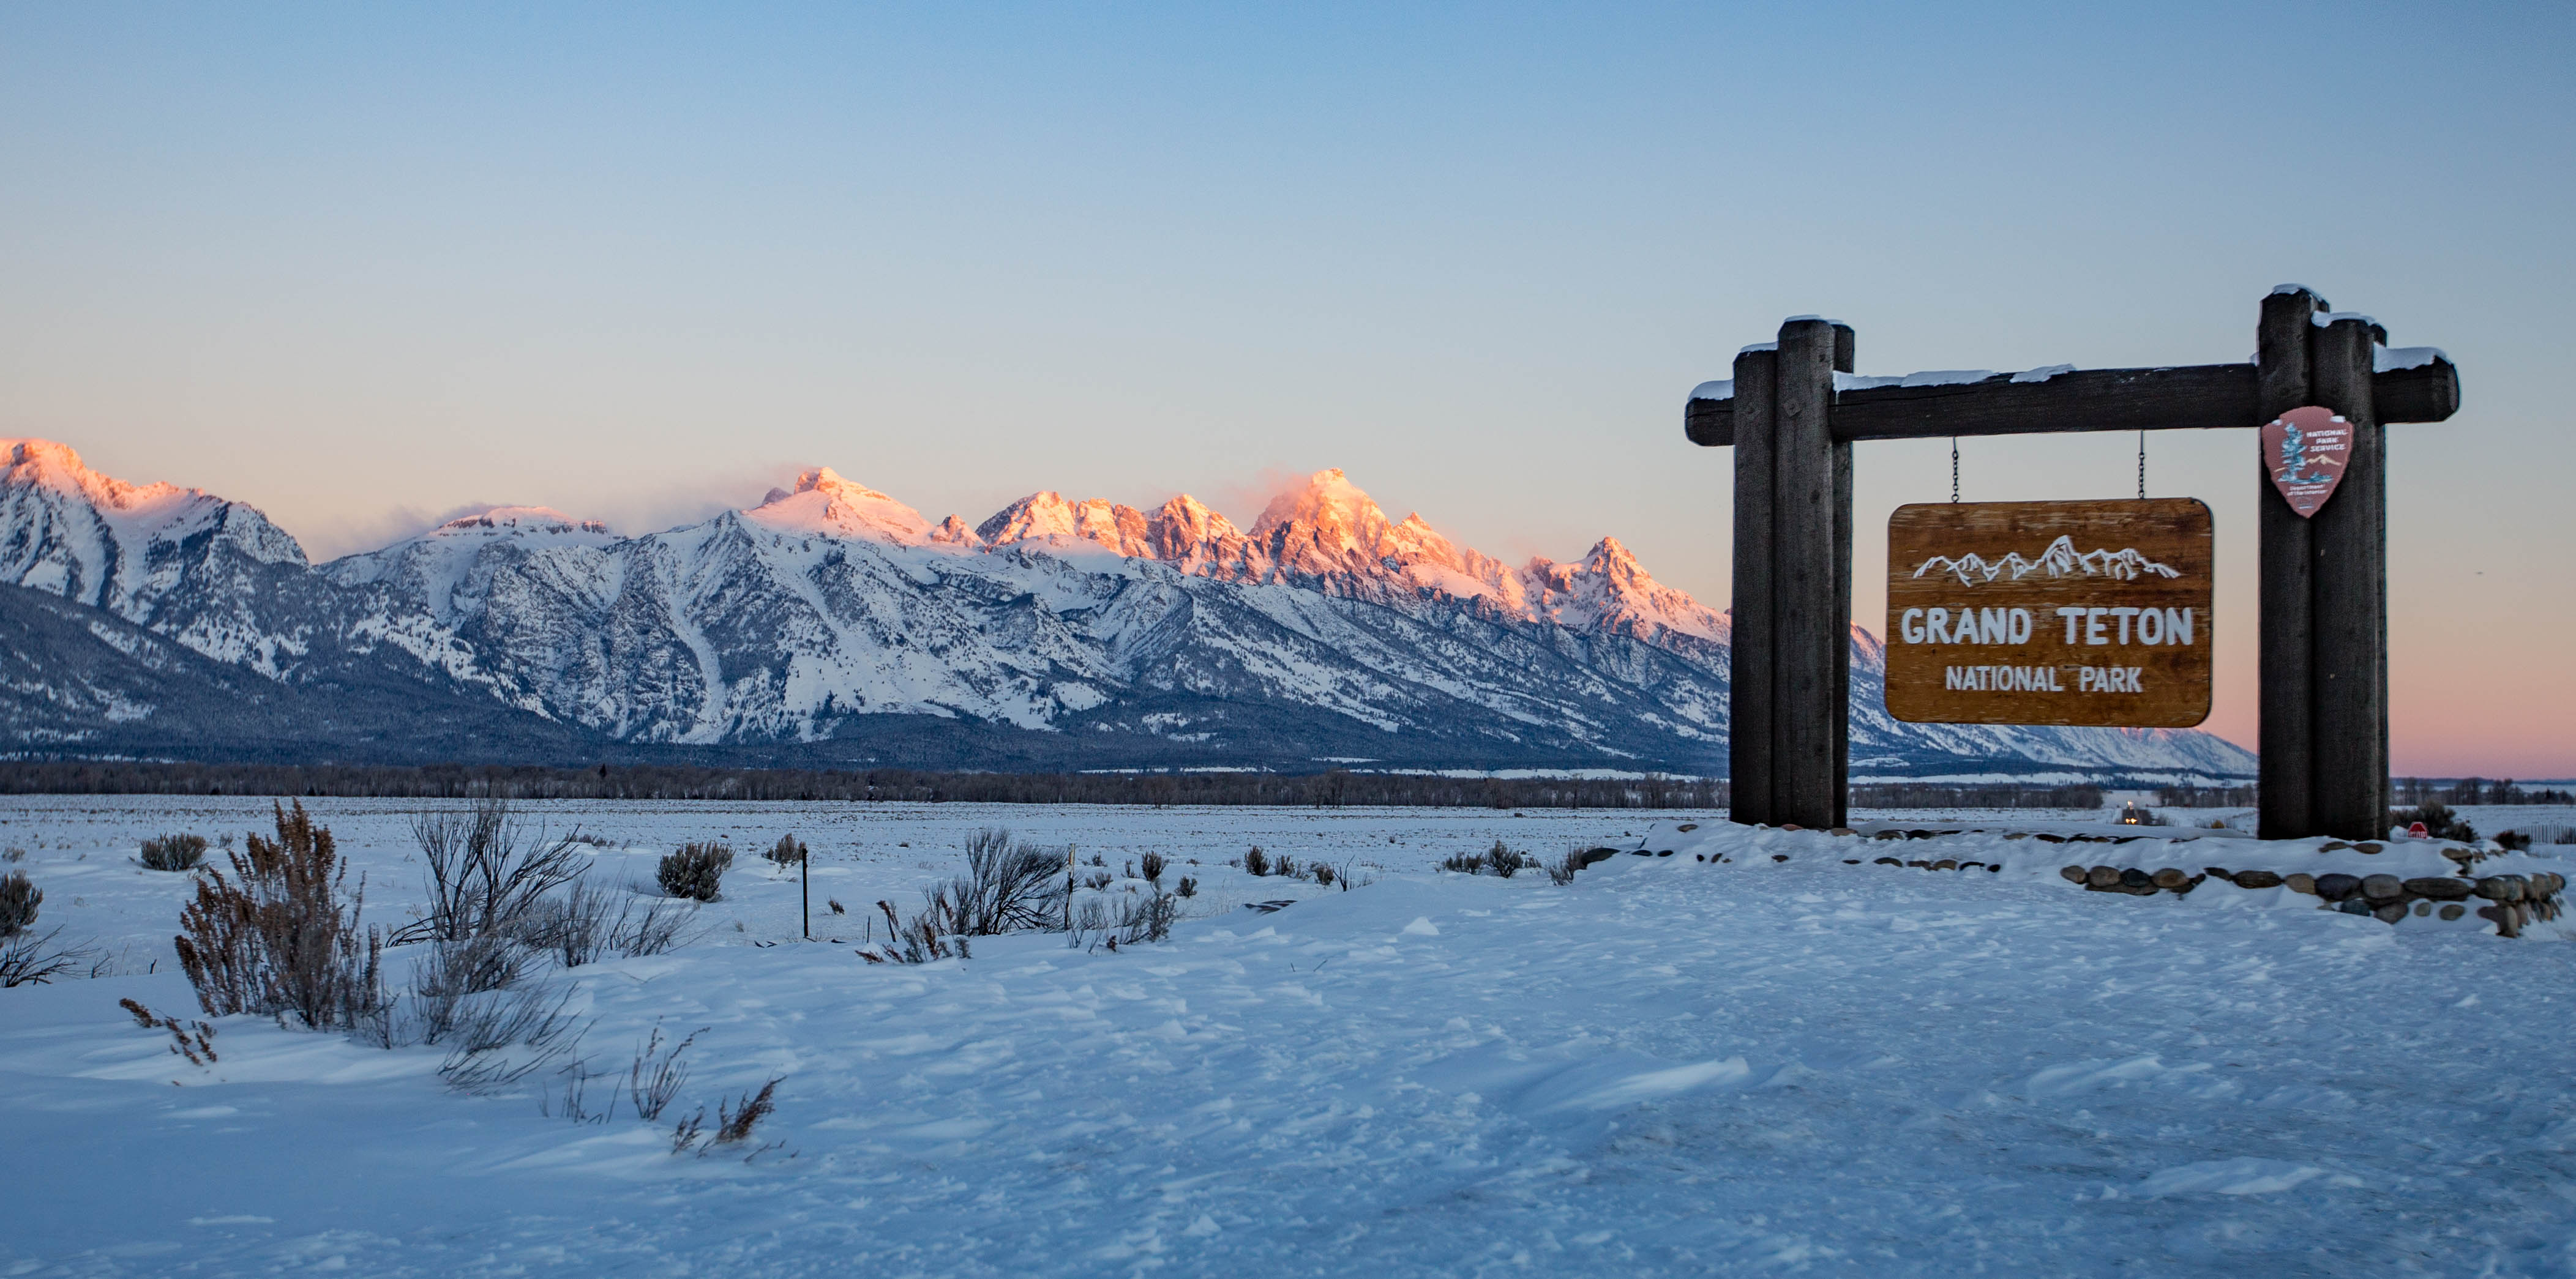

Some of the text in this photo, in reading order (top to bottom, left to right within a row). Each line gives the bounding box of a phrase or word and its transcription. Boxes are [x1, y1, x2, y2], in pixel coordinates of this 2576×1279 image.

[2310, 444, 2346, 452] SERVICE
[1901, 607, 2193, 646] GRAND TETON
[1946, 666, 2143, 693] NATIONAL PARK
